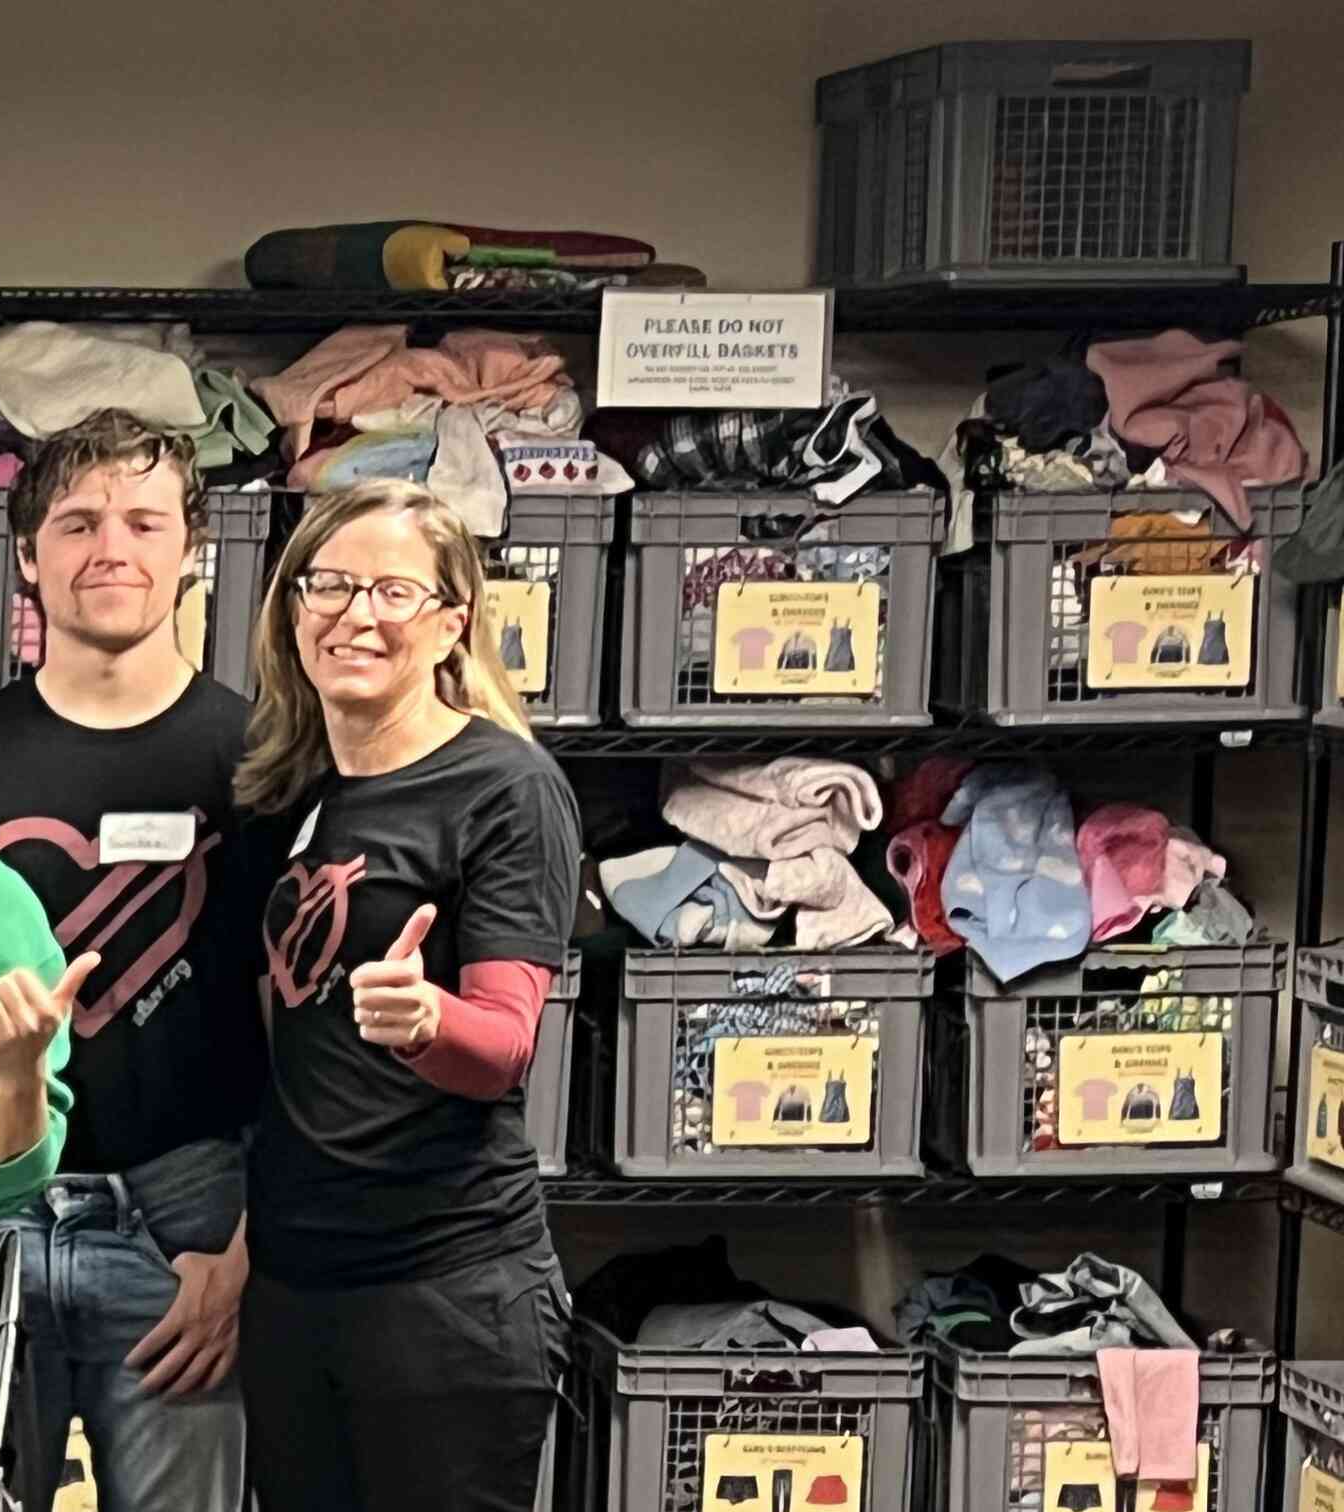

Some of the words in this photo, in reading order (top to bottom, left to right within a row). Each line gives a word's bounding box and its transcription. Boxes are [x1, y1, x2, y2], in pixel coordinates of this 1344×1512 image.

[644, 318, 712, 335] PLEASE
[718, 318, 743, 335] DO
[749, 318, 785, 335] NOT
[626, 342, 711, 360] OVERFILL
[718, 342, 799, 360] BASKETS
